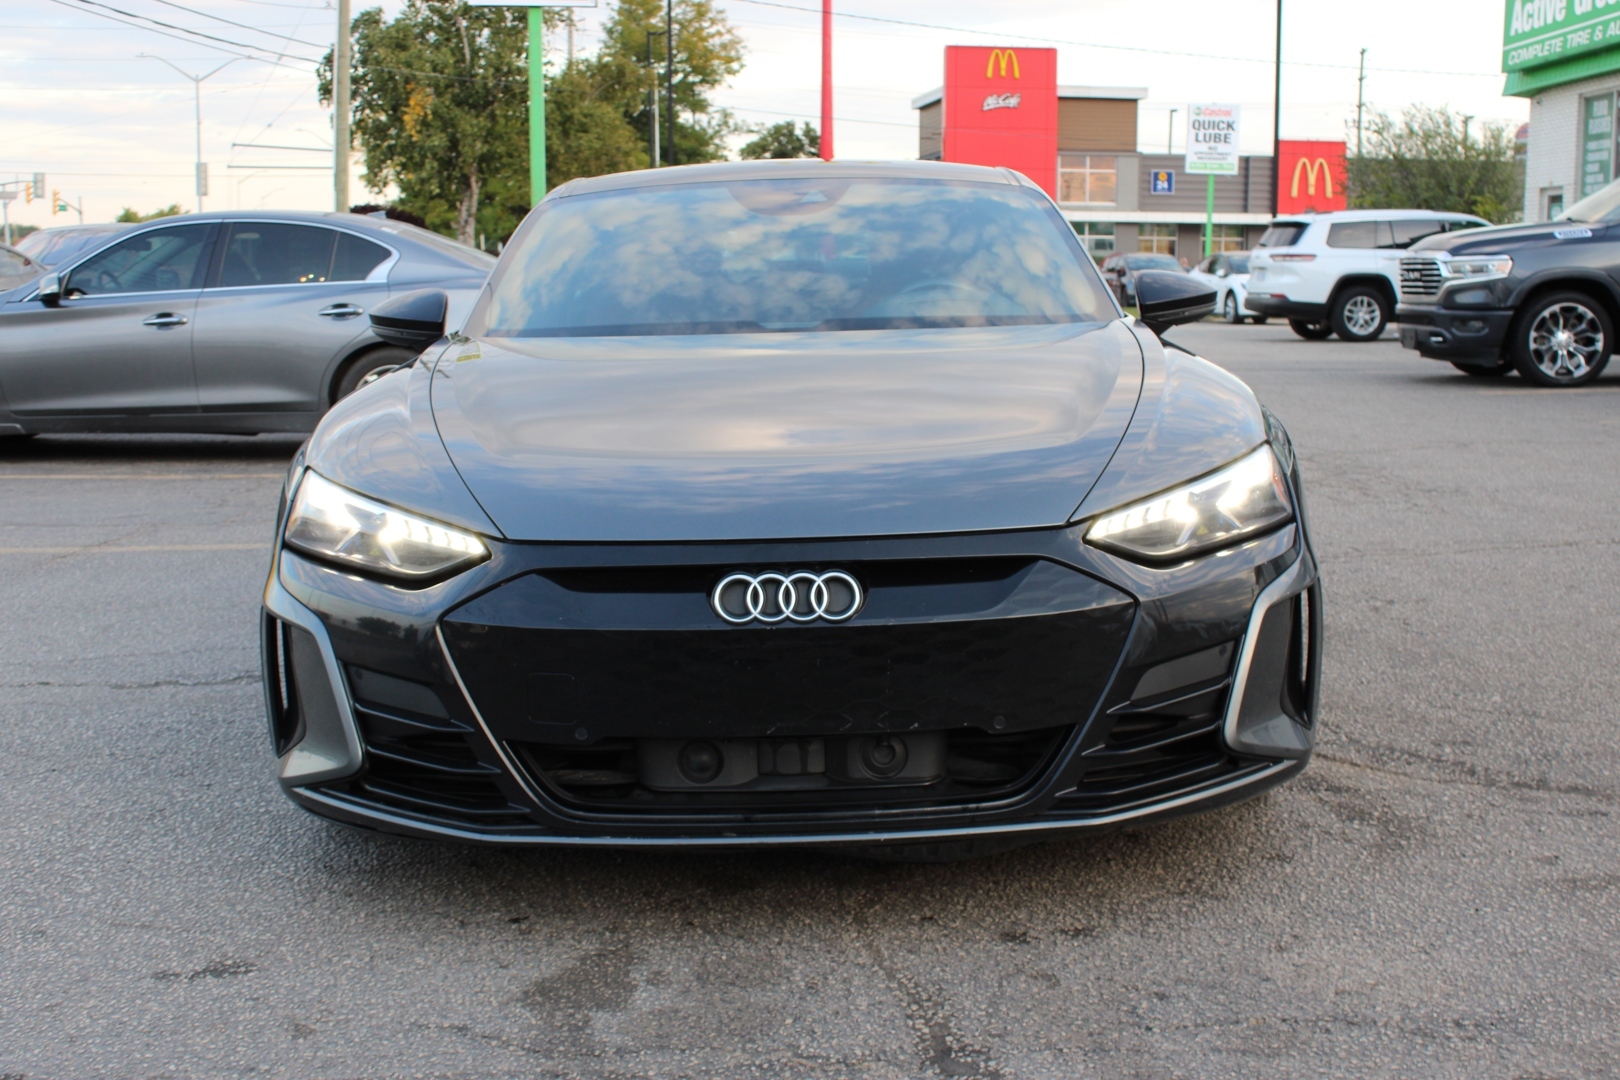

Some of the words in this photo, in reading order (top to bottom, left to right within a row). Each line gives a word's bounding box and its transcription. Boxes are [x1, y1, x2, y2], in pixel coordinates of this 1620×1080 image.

[1510, 0, 1566, 36] Active
[1508, 37, 1563, 65] COMPLETE
[1567, 28, 1591, 48] TIRE
[1593, 25, 1603, 41] &
[1192, 119, 1236, 132] QUICK
[1195, 132, 1232, 144] LUBE
